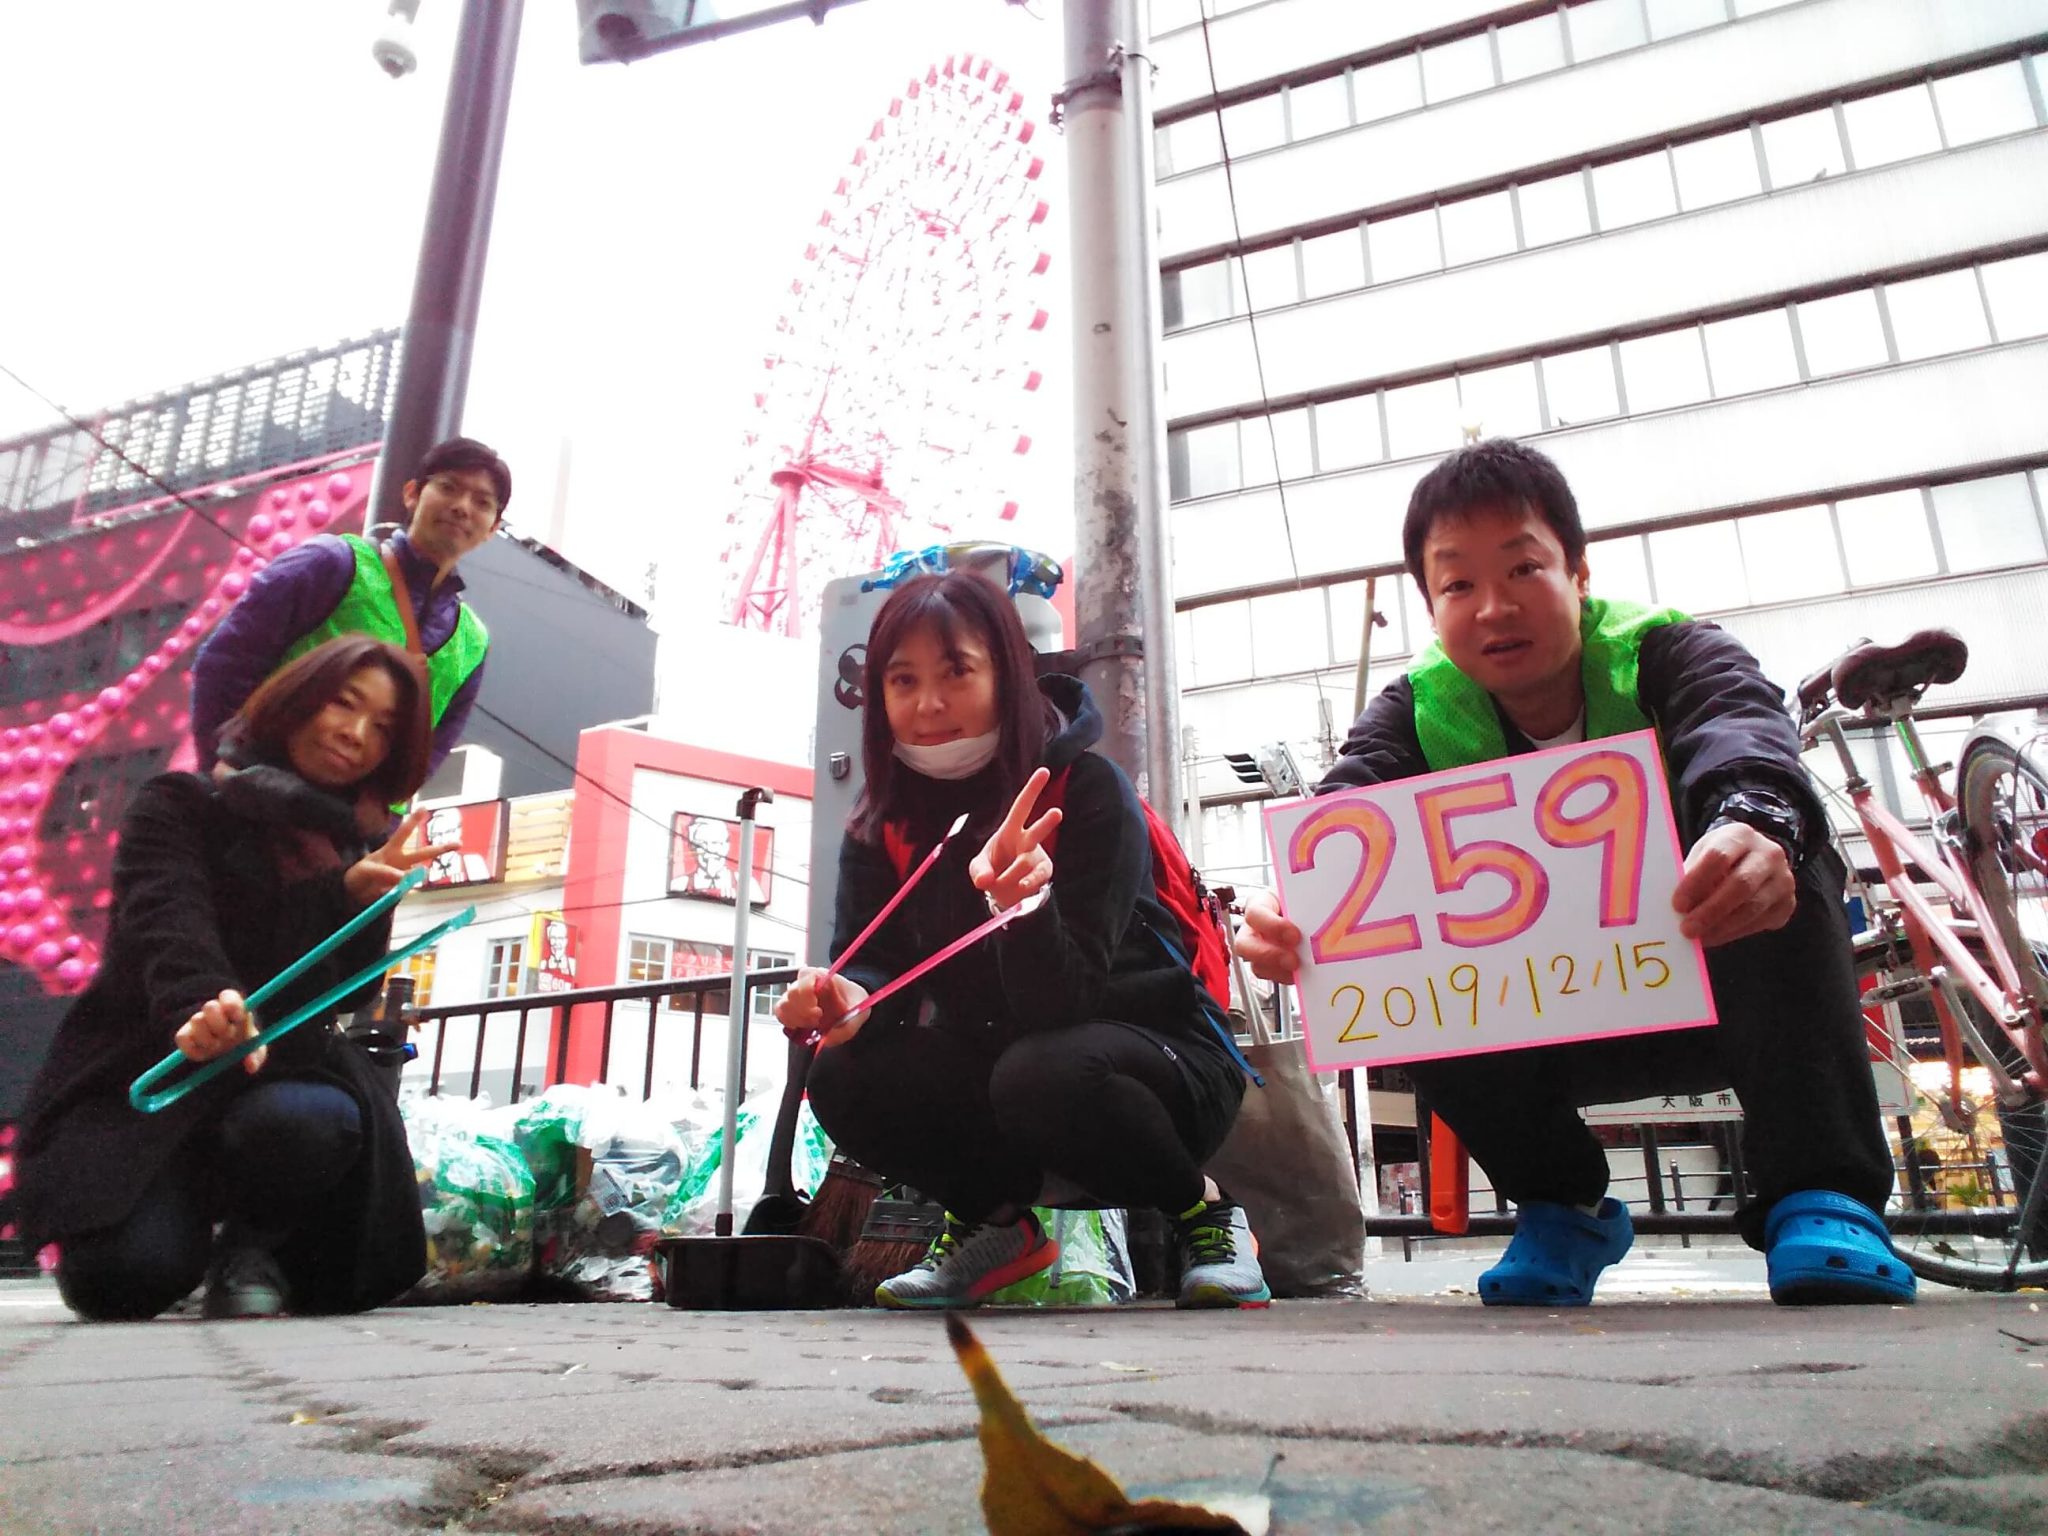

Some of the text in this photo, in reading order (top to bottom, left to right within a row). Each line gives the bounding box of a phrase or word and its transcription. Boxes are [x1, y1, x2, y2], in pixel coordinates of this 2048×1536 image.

[1288, 750, 1648, 965] 259
[1331, 941, 1671, 1044] 2019/12/15
[1662, 1093, 1731, 1108] 大阪市
